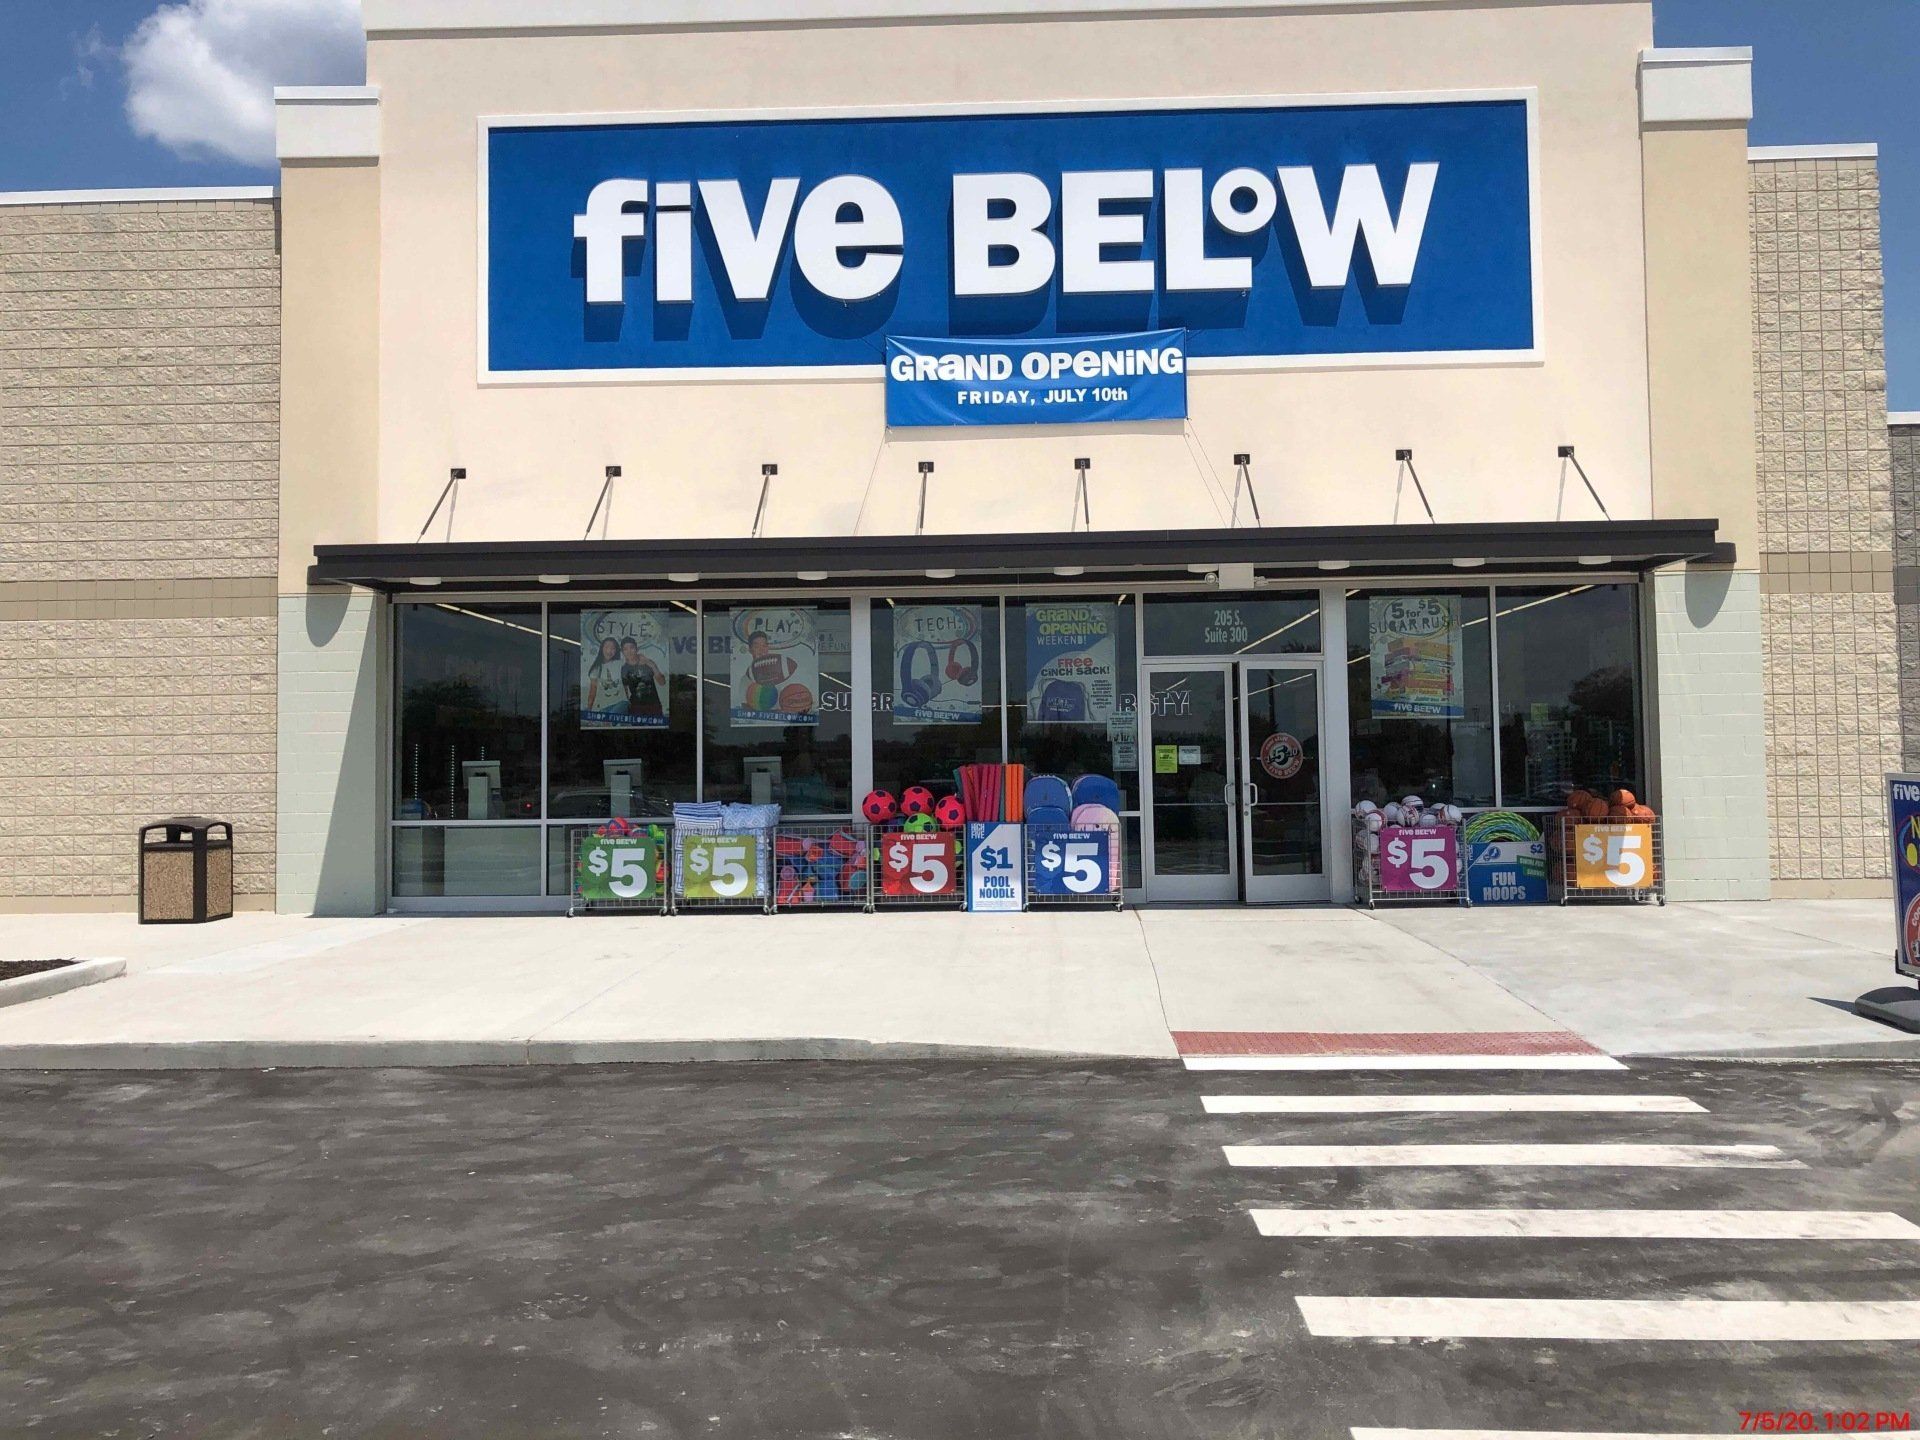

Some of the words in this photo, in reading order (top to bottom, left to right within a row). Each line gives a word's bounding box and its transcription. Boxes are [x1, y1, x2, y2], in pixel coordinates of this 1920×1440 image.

[574, 175, 903, 303] five
[953, 162, 1439, 297] BELOW
[957, 390, 1035, 406] FRIDAY,
[1043, 388, 1087, 403] JULY
[1091, 386, 1128, 402] 10th
[1214, 609, 1233, 626] 205
[1391, 602, 1404, 619] 5
[1406, 609, 1421, 618] for
[1204, 627, 1228, 643] Suite
[1229, 626, 1248, 643] 300
[1370, 617, 1417, 634] SUGAR
[980, 845, 1013, 871] $1
[1530, 844, 1543, 854] $2
[888, 842, 948, 893] $5
[1041, 841, 1101, 893] $5
[1387, 838, 1449, 889] $5
[1582, 834, 1645, 887] $5
[588, 846, 647, 897] $5
[689, 845, 749, 896] $5
[1491, 871, 1516, 885] FUN
[984, 876, 1010, 887] POOL
[979, 888, 1015, 898] NOODLE
[1483, 885, 1526, 901] HOOPS
